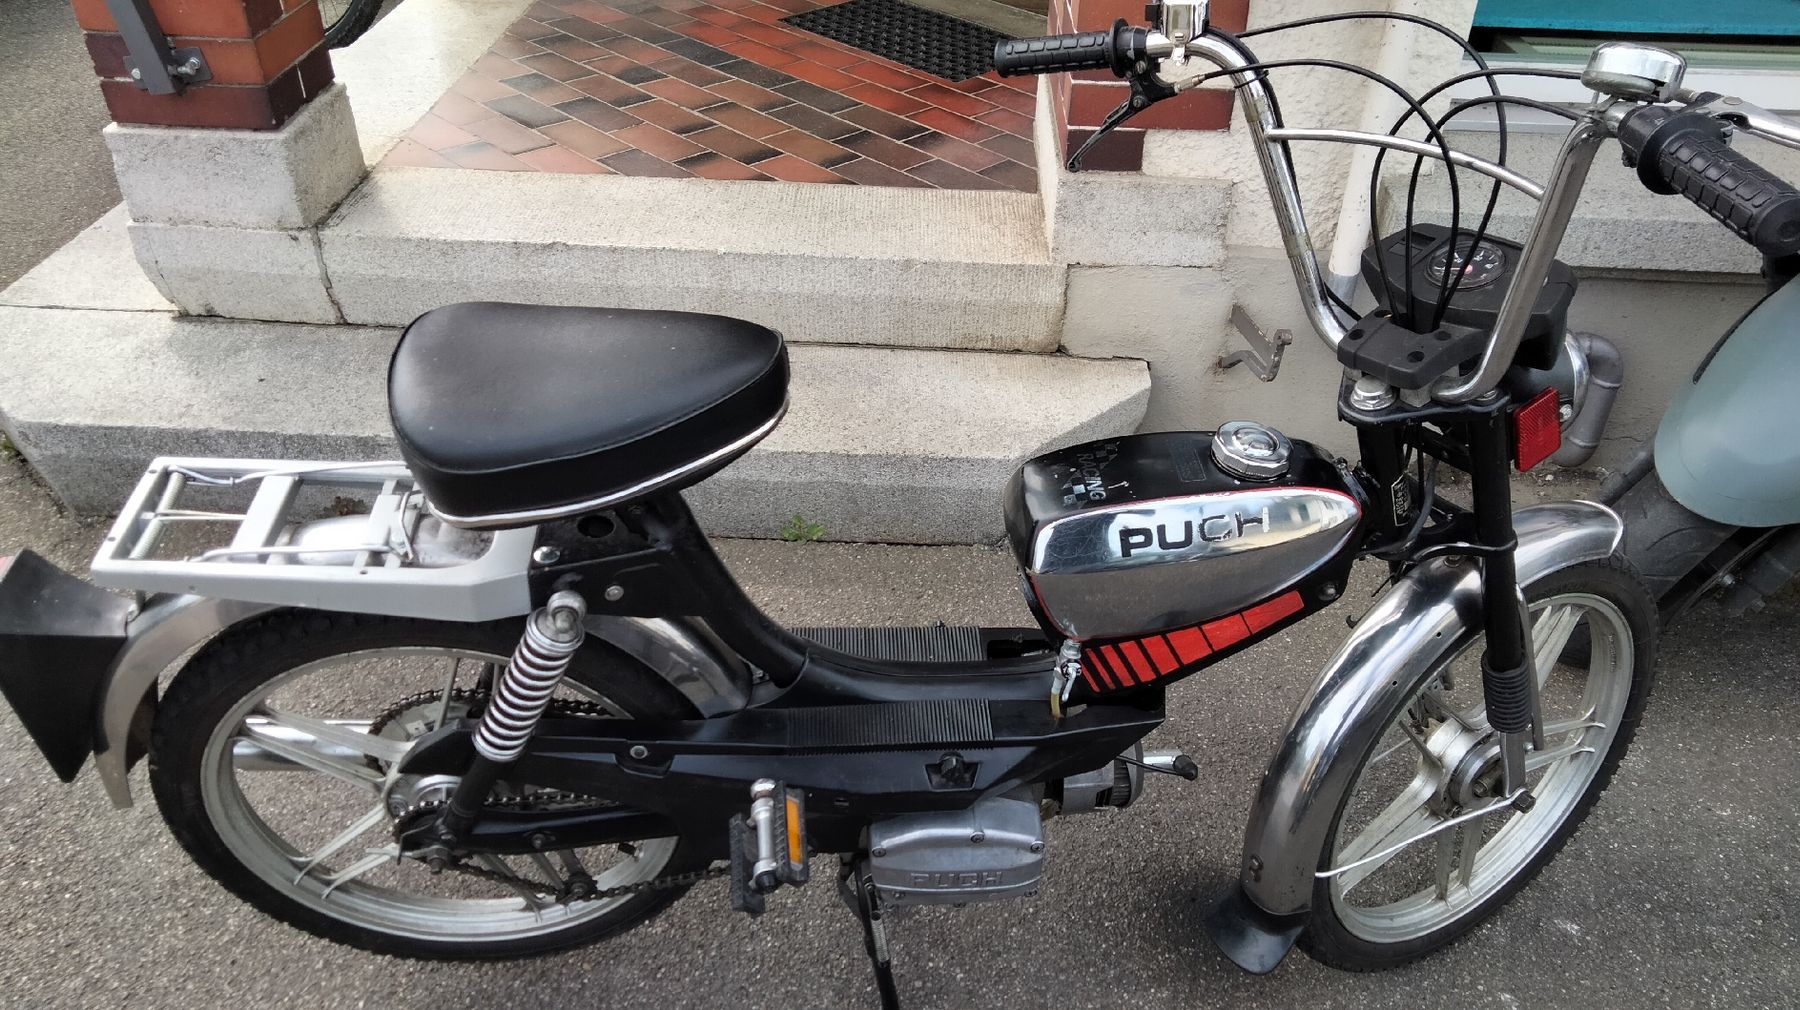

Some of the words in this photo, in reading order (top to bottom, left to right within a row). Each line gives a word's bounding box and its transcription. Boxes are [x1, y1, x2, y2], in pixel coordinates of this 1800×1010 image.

[1076, 453, 1107, 500] RACING
[1119, 507, 1270, 558] PUCH
[911, 872, 1002, 887] PUCH
